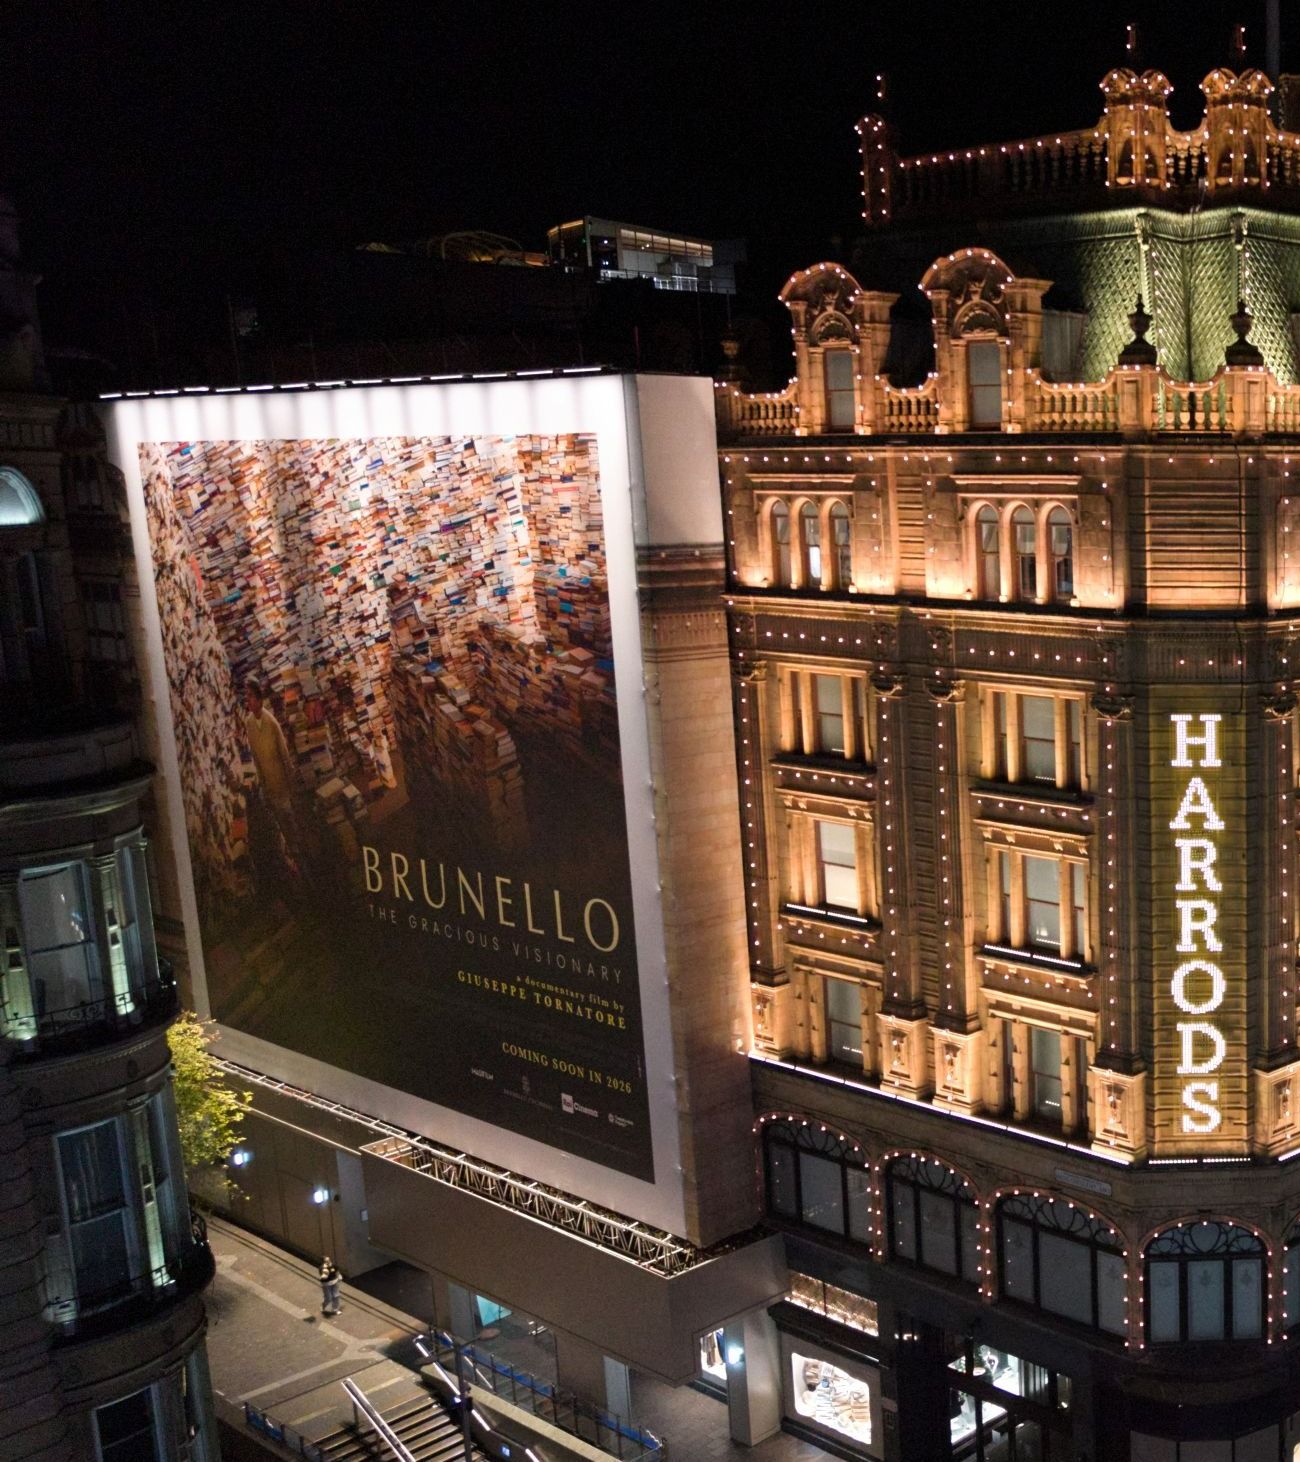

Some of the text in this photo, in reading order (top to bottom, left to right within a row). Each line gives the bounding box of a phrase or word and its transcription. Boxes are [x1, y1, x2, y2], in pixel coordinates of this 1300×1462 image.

[363, 846, 619, 953] BRUNELLO
[1169, 714, 1226, 1133] HARRODS
[369, 904, 622, 984] THE GRACIOUS VISIONARY
[457, 970, 626, 1030] GIUSEPPE TORNATORE
[525, 975, 585, 1002] documentary
[589, 993, 609, 1007] film
[613, 999, 624, 1013] by
[502, 1042, 632, 1094] COMING SOON IN 2026
